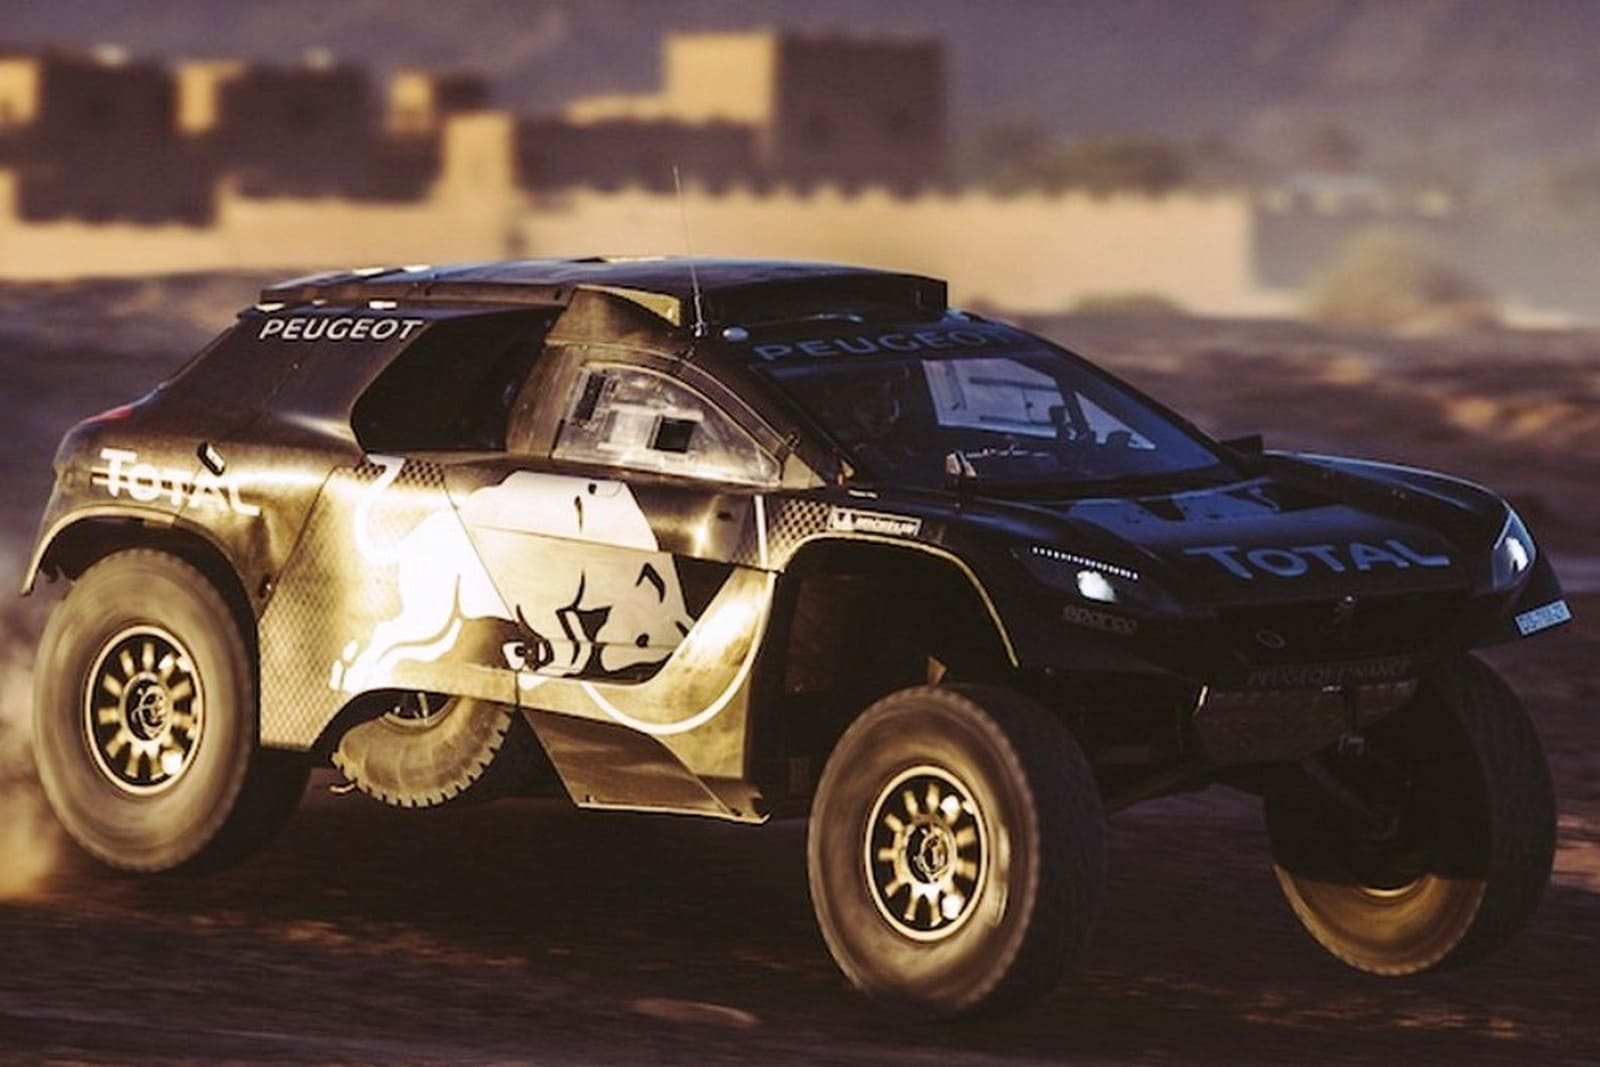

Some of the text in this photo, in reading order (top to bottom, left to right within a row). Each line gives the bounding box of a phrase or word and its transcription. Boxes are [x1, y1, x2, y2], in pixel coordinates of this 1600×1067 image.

[258, 318, 424, 341] PEUGEOT
[99, 447, 262, 517] TOTAL
[1183, 538, 1451, 581] TOTAL
